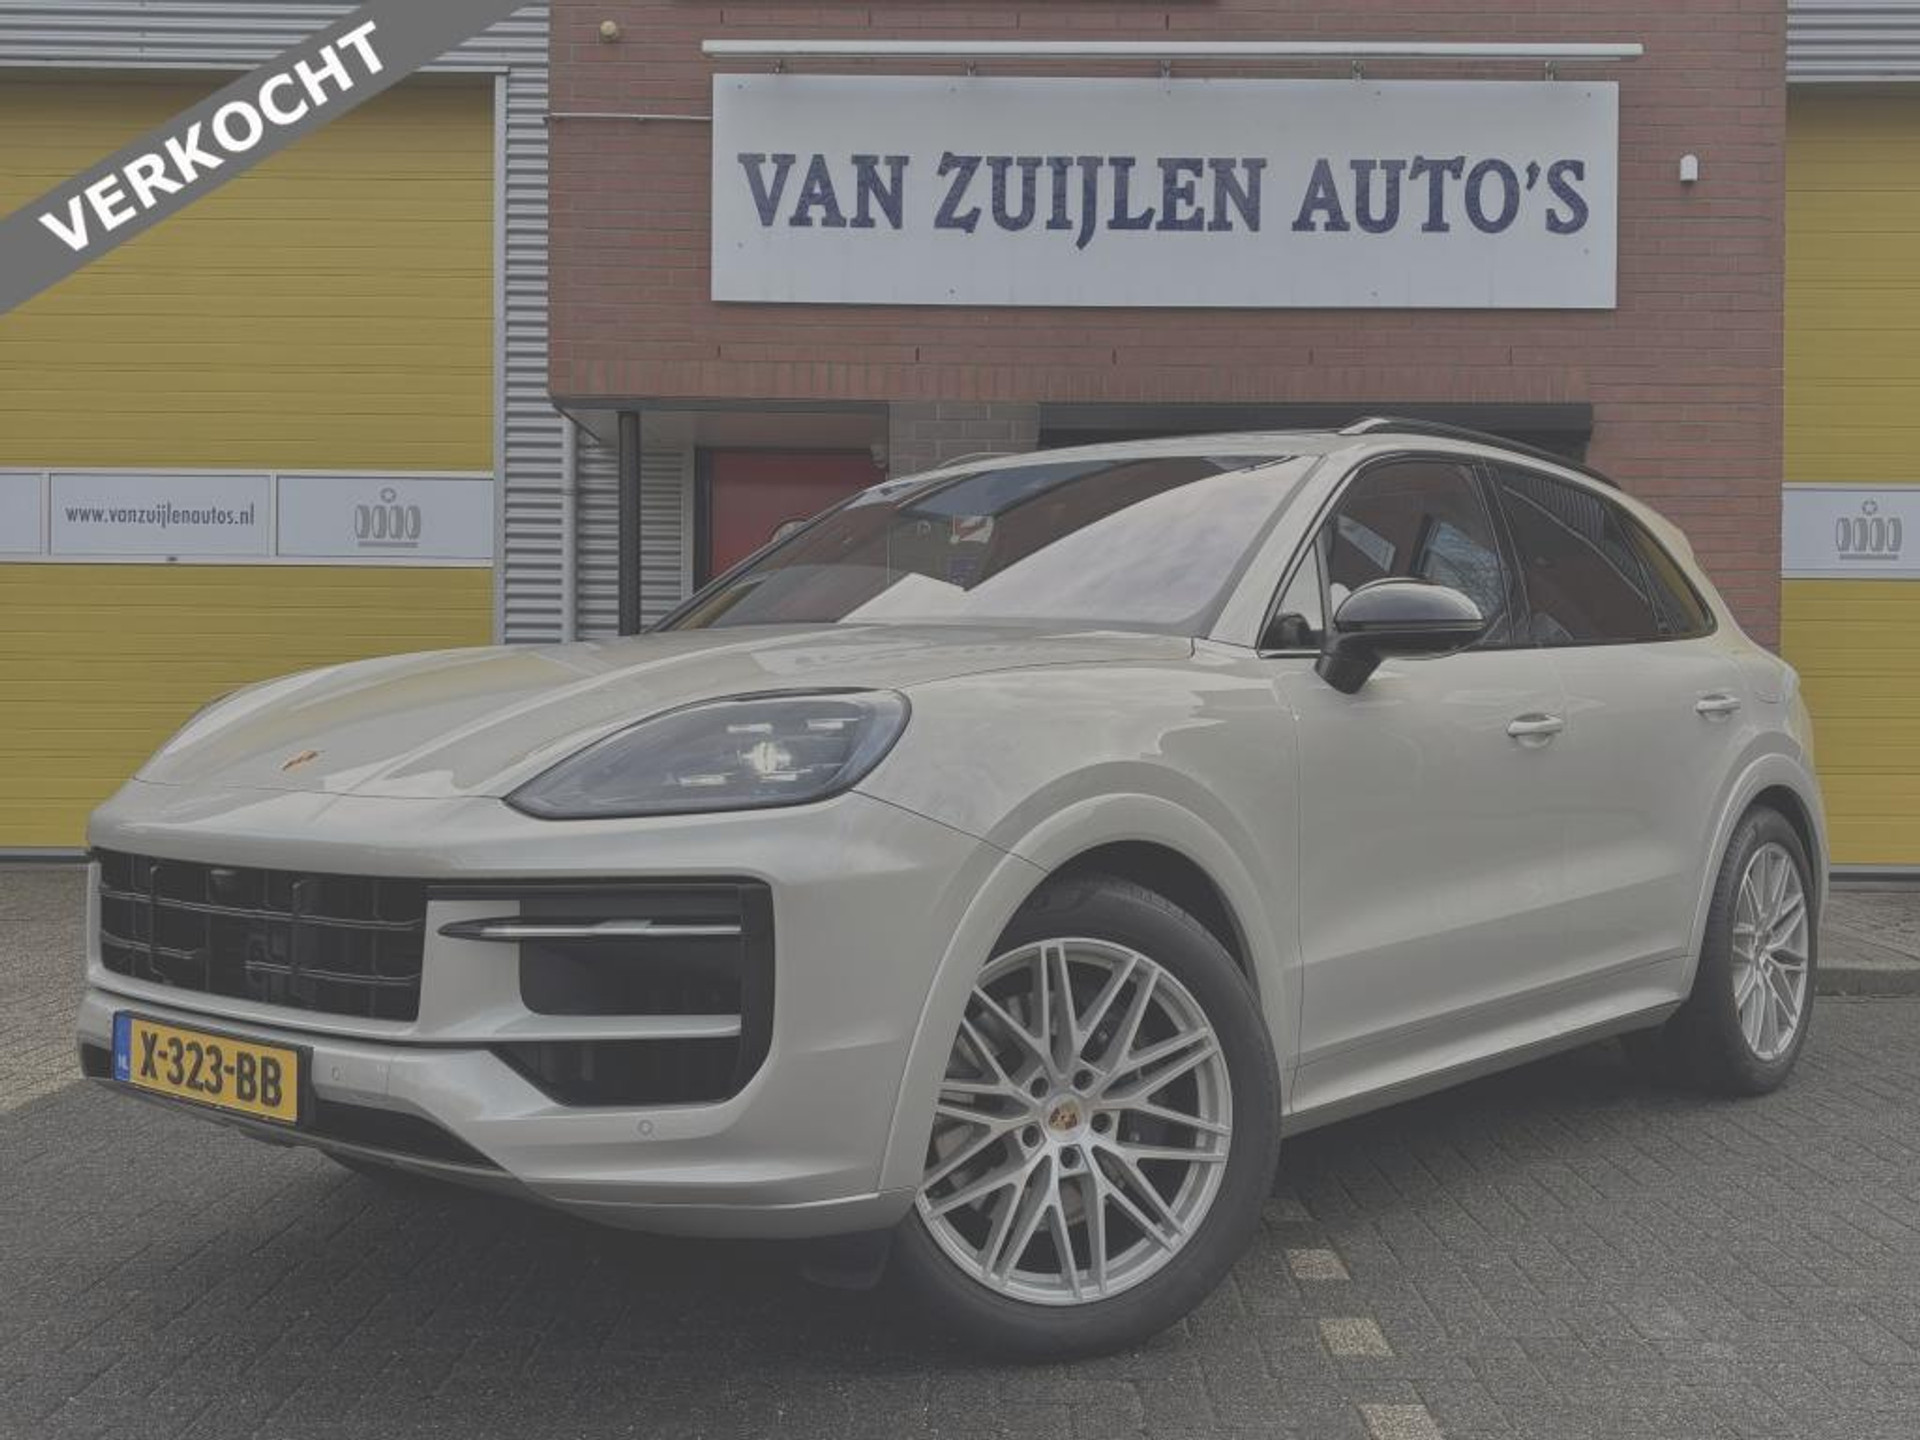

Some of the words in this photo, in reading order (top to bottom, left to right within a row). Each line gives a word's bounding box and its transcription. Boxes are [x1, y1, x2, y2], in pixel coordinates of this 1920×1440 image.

[738, 153, 910, 229] VAN
[934, 151, 1267, 250] ZUIJLEN
[1292, 156, 1590, 234] AUTO'S
[65, 503, 255, 528] www.vanzuijlenautos.nl
[140, 1031, 283, 1108] X-323-BB
